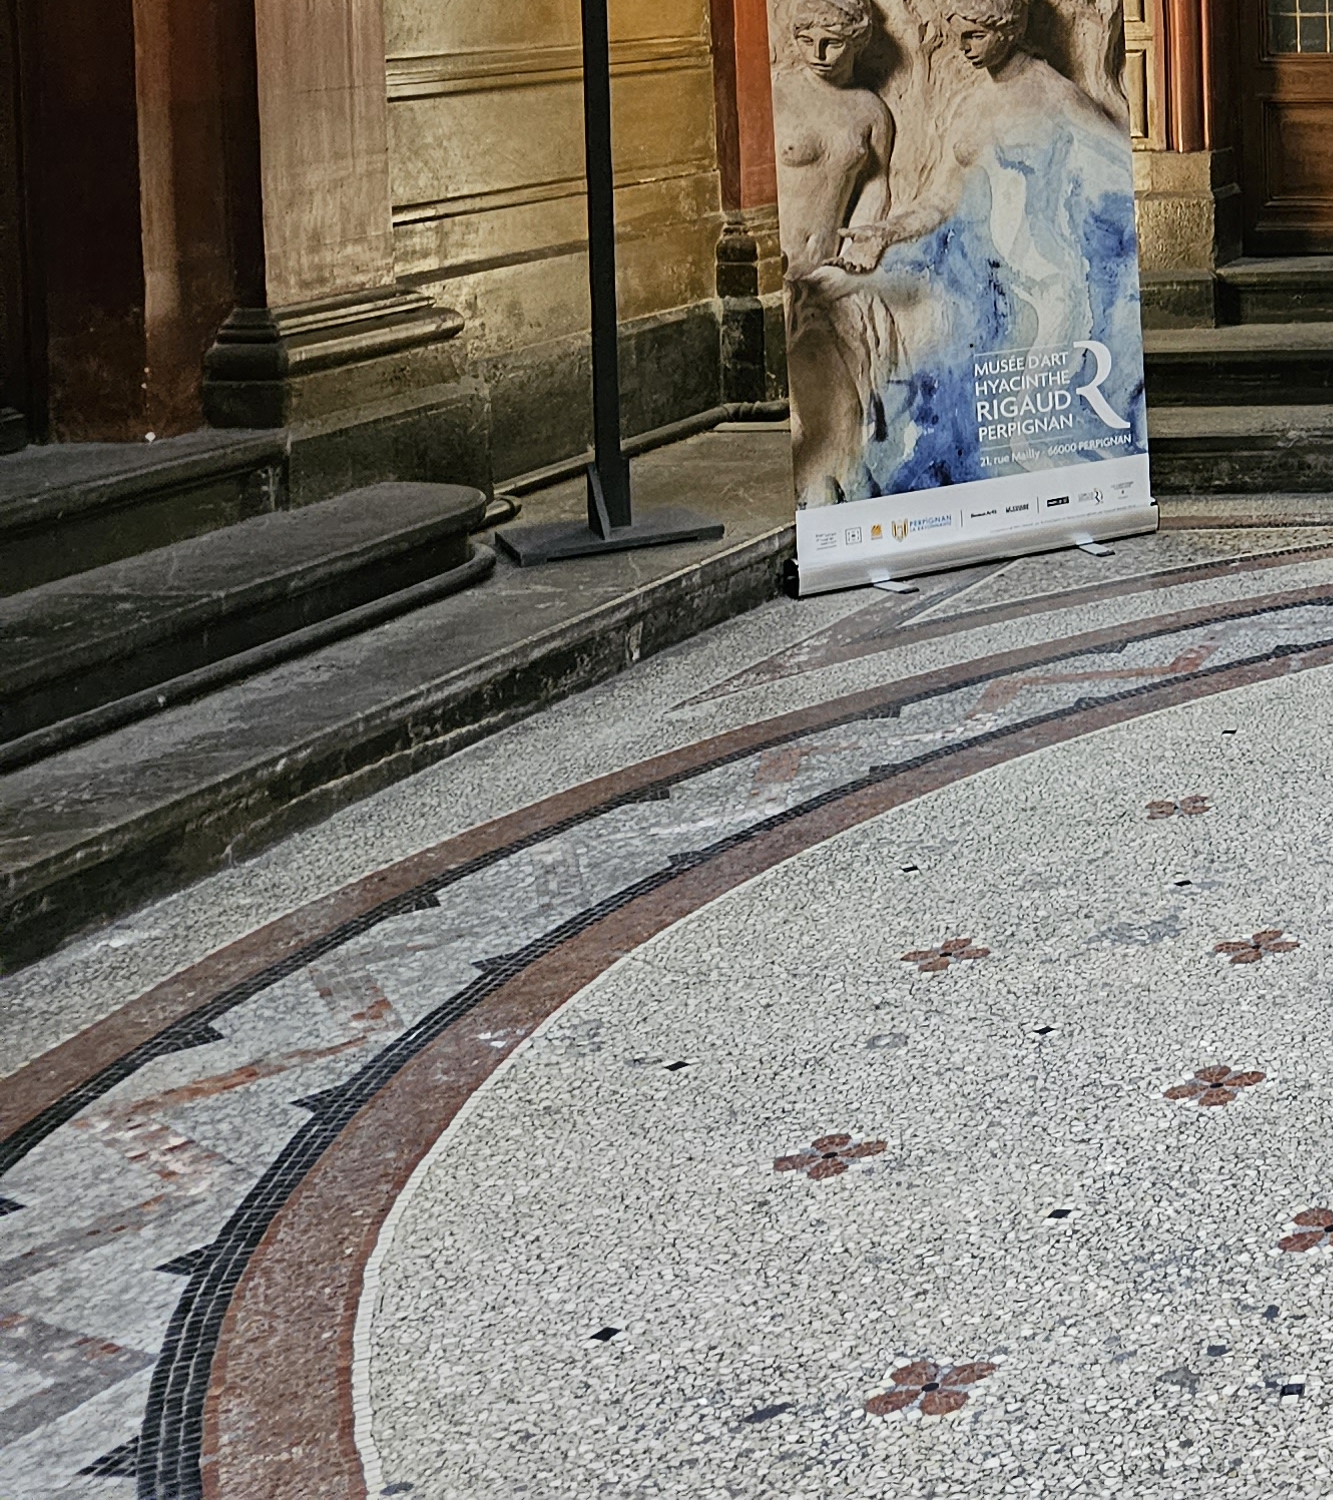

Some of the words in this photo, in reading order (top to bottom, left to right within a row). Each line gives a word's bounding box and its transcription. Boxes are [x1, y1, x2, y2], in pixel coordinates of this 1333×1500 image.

[974, 355, 1025, 378] MUSÉE
[1028, 352, 1068, 370] D'ART
[975, 370, 1070, 397] HYACINTHE
[977, 390, 1072, 423] RIGAUD
[978, 413, 1073, 442] PERPIGNAN
[994, 455, 1010, 465] rue
[1079, 434, 1132, 451] PERPIGNAN
